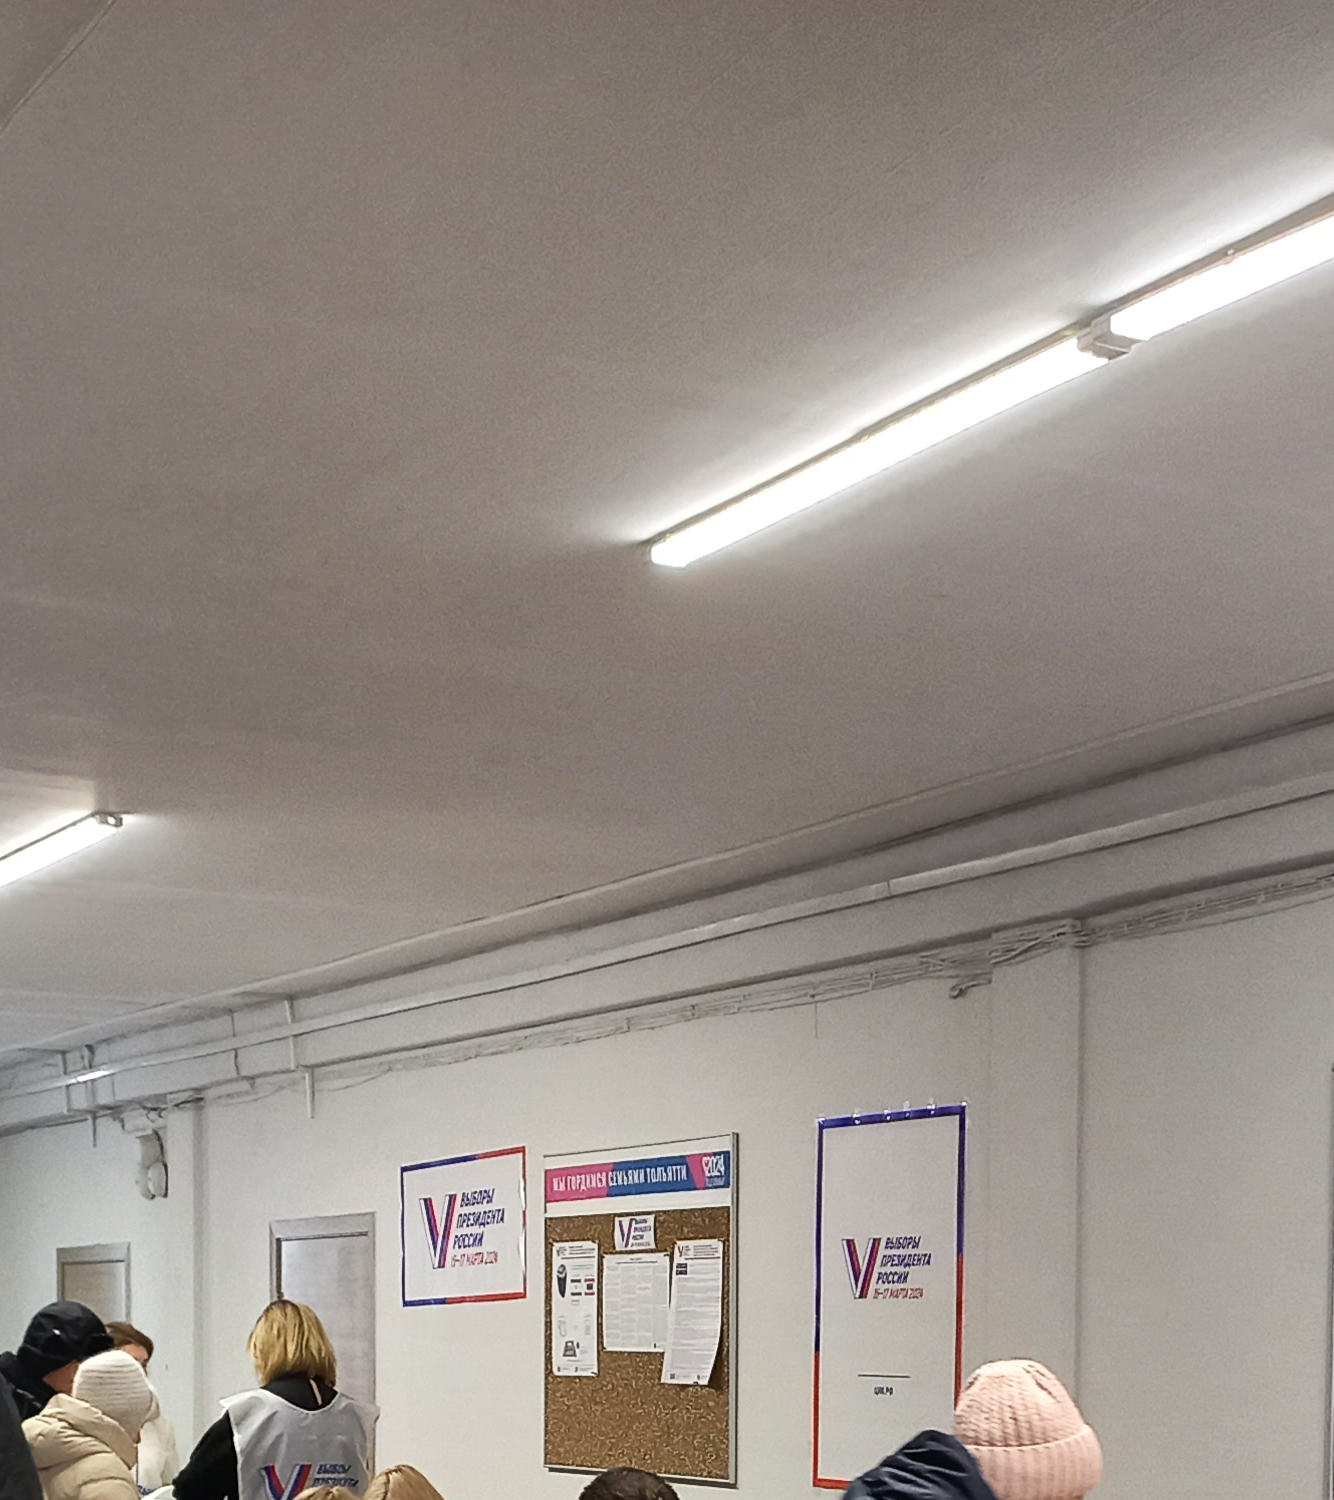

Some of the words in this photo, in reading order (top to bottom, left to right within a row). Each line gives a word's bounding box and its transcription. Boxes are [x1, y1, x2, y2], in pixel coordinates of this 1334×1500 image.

[553, 1176, 566, 1192] МЫ
[567, 1172, 607, 1192] ГОРДИМСЯ
[608, 1168, 645, 1187] СЕМЬЯМИ
[646, 1164, 687, 1183] ТОЛЬЯТТИ
[460, 1188, 495, 1208] ВЫБОРЫ
[455, 1208, 505, 1229] ПРЕЗИДЕНТА
[452, 1230, 485, 1250] РОССИИ
[884, 1235, 922, 1250] ВЫБОРЫ
[880, 1253, 932, 1269] ПРЕЗИДЕНТА
[875, 1271, 910, 1285] РОССИИ
